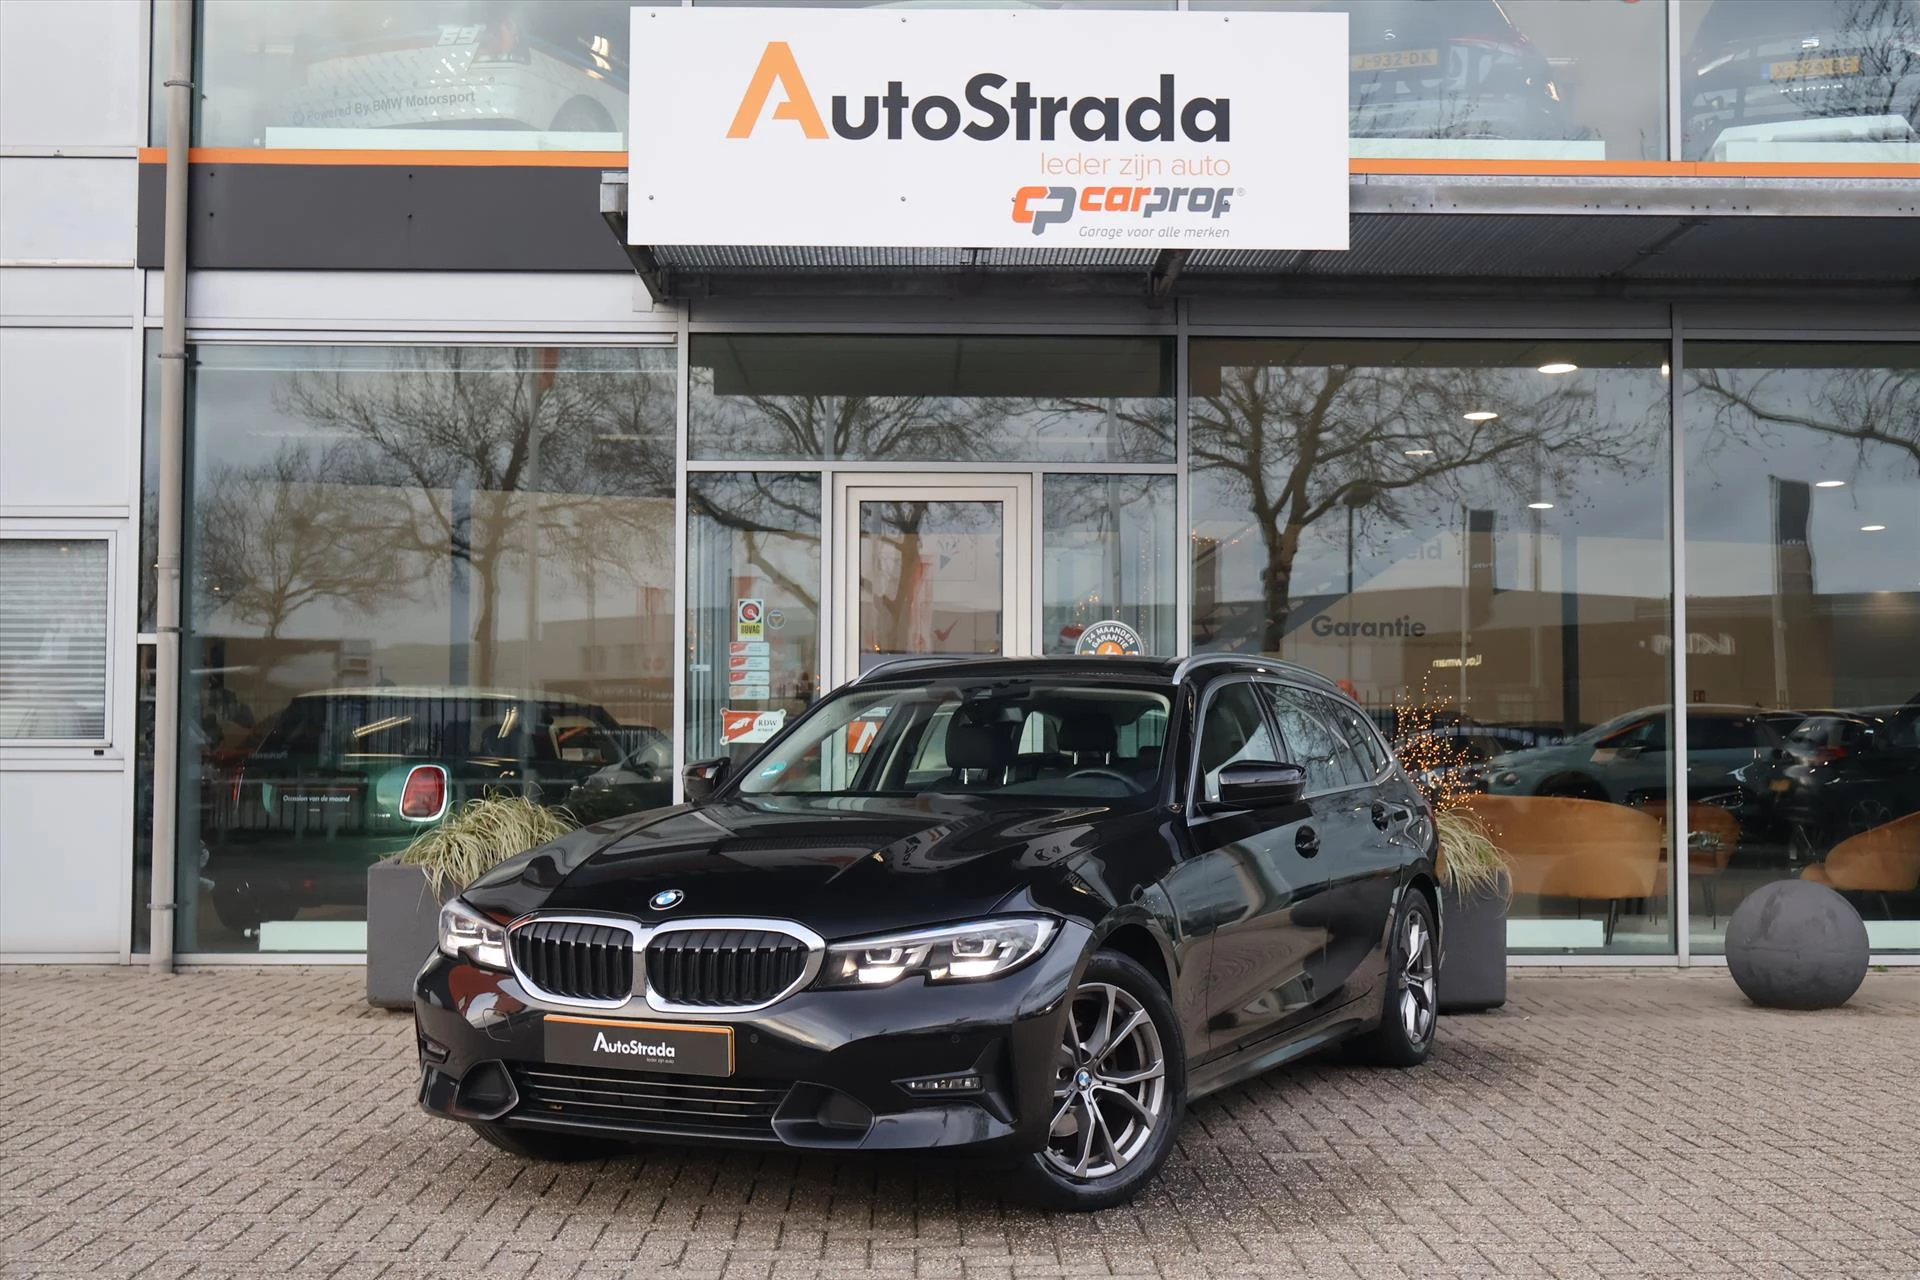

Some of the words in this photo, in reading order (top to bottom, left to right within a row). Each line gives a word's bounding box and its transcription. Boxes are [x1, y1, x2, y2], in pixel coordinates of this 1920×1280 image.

[726, 41, 1230, 142] AutoStrada
[306, 104, 351, 122] Powered
[354, 103, 371, 116] By
[372, 98, 402, 112] BMW
[405, 92, 476, 108] Motorsport
[1040, 152, 1111, 176] Ieder
[1119, 154, 1162, 181] zijn
[1171, 155, 1231, 177] auto
[1080, 186, 1234, 218] carprof
[1079, 226, 1128, 240] Garage
[1128, 227, 1156, 238] voor
[1158, 226, 1182, 238] alle
[1184, 227, 1230, 239] merken
[1085, 632, 1096, 644] 24
[1096, 626, 1136, 645] MAANDEN
[1311, 614, 1427, 638] Garantie
[1091, 633, 1130, 649] GARANTIE
[593, 1031, 675, 1057] AutoStrada
